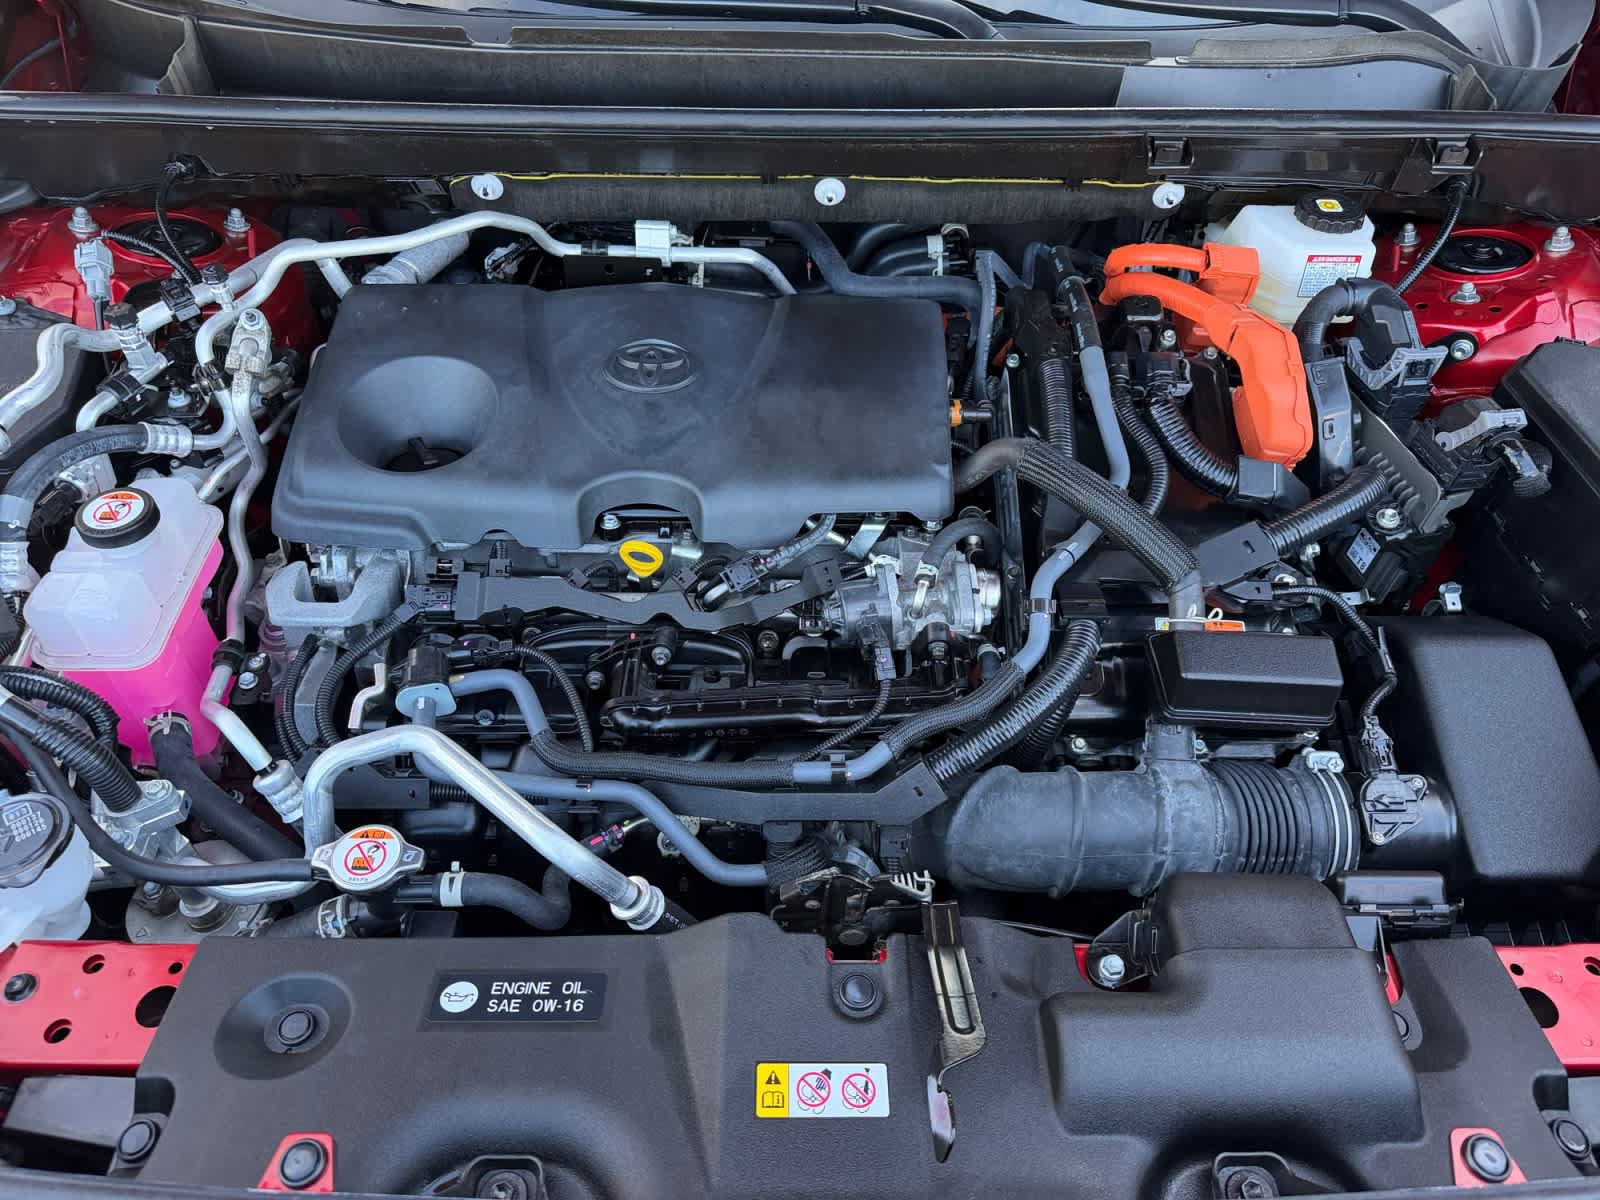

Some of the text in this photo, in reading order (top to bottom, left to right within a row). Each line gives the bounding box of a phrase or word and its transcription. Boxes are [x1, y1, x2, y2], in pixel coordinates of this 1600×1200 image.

[491, 981, 587, 995] ENGINE OIL
[487, 999, 584, 1013] SAE 0W-16
